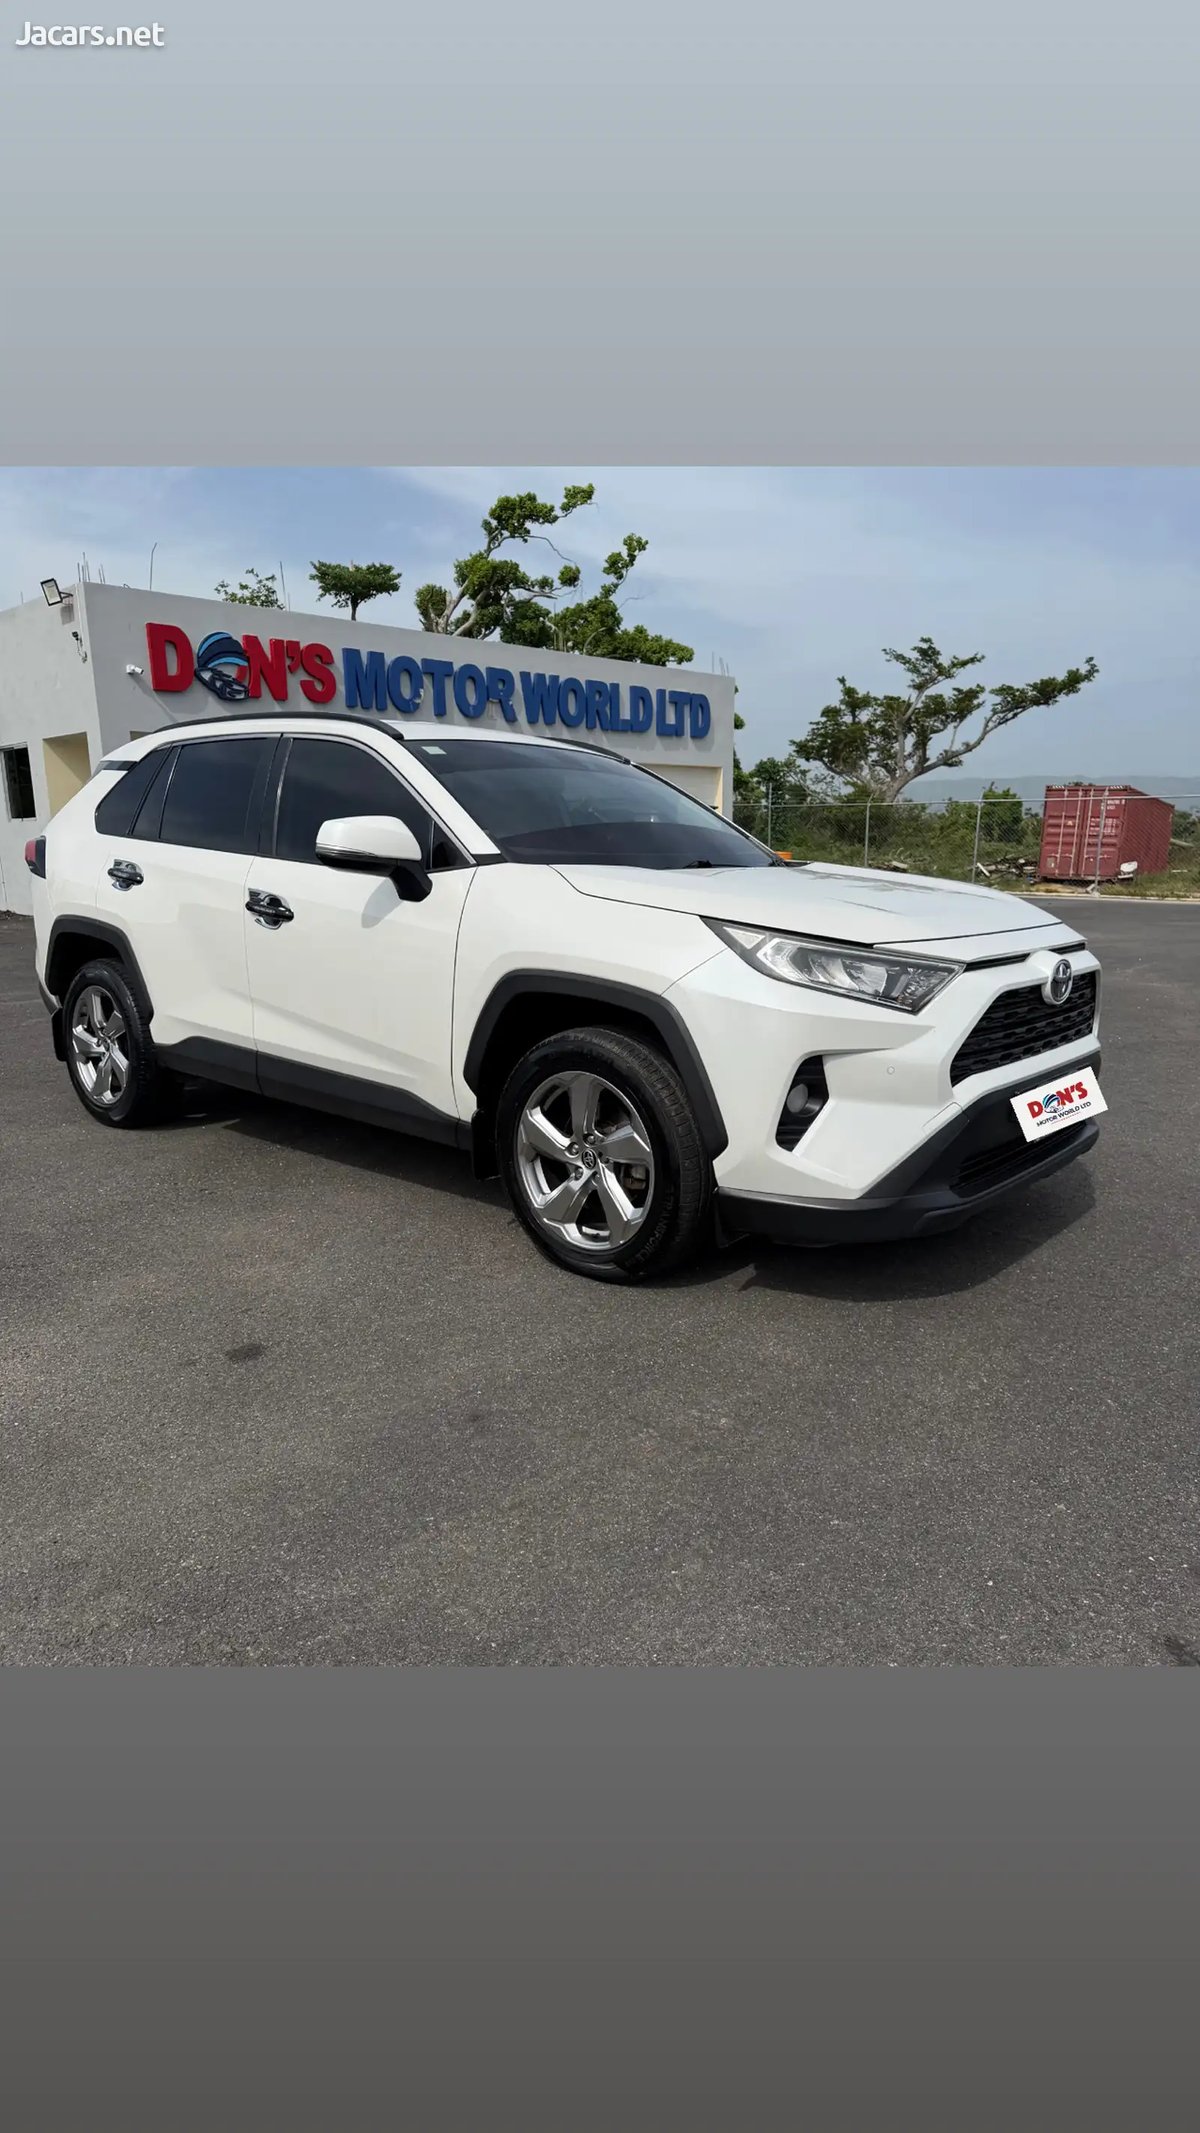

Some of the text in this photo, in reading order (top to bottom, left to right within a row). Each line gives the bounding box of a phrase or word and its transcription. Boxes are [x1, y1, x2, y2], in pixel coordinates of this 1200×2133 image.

[342, 647, 517, 723] MOTOR
[519, 670, 654, 734] WORLD
[656, 687, 712, 739] LTD
[1036, 1115, 1058, 1127] MOTOR
[1058, 1105, 1080, 1118] WORLD
[1080, 1101, 1092, 1109] LTD
